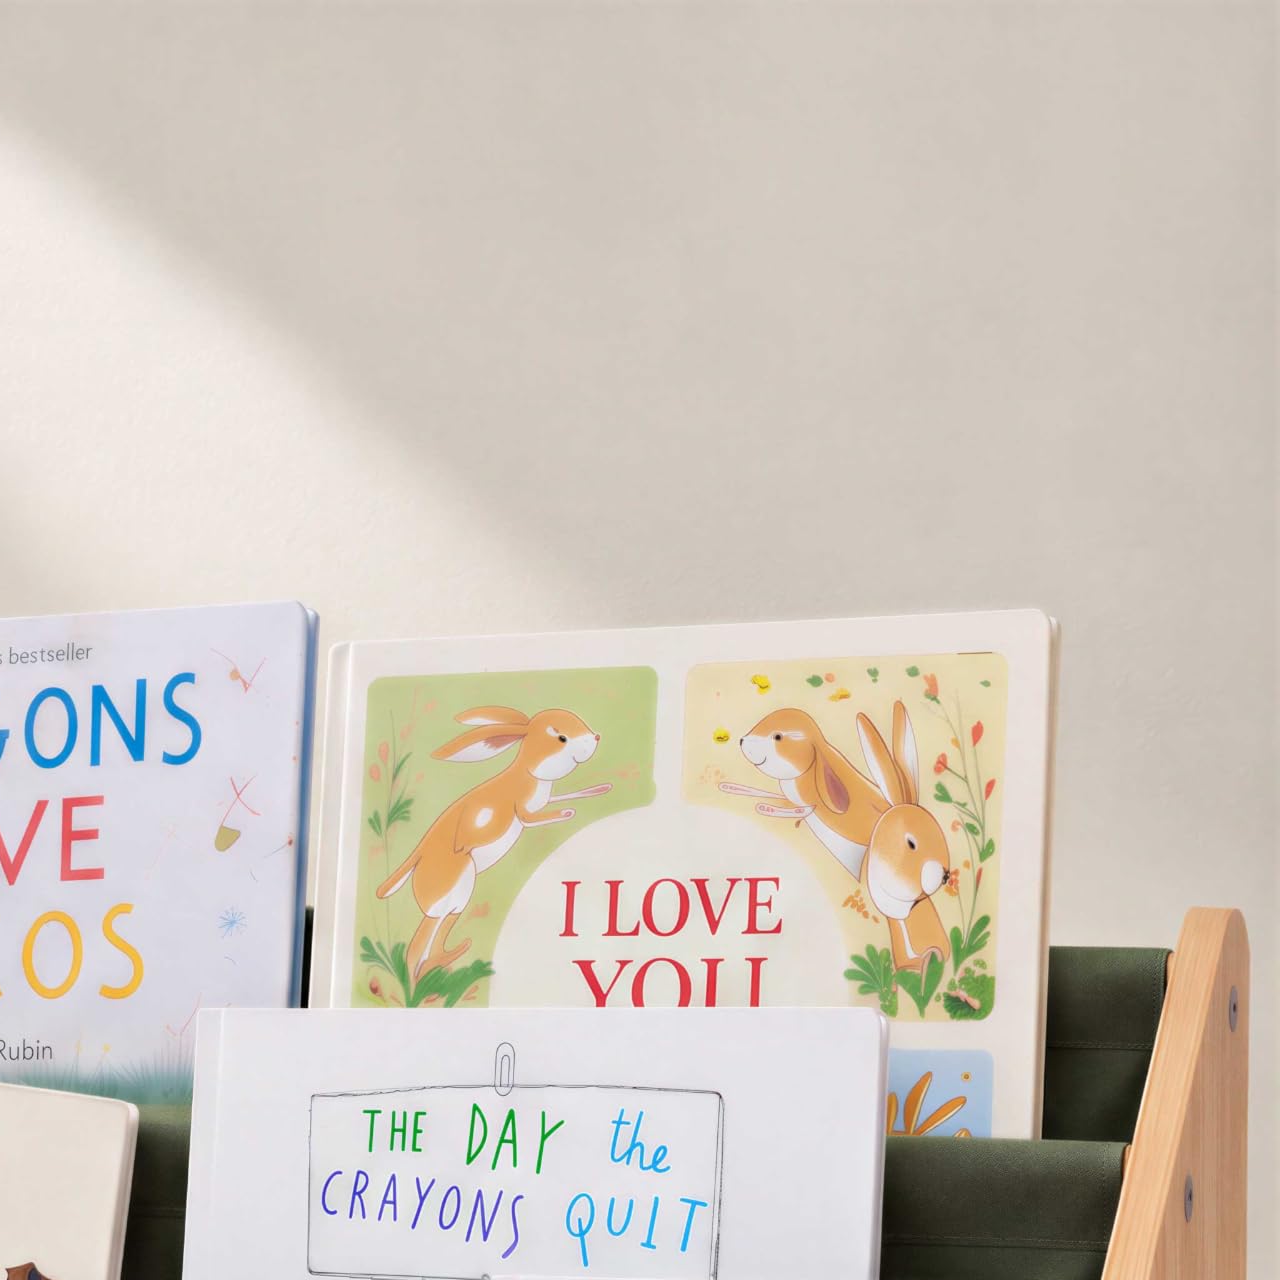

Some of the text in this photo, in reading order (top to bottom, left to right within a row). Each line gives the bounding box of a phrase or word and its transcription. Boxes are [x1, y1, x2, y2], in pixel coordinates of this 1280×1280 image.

[8, 642, 93, 665] bestseller
[558, 876, 783, 937] I LOVE
[362, 1102, 671, 1174] THE DAY the
[321, 1170, 709, 1267] CRAYONS QUIT
